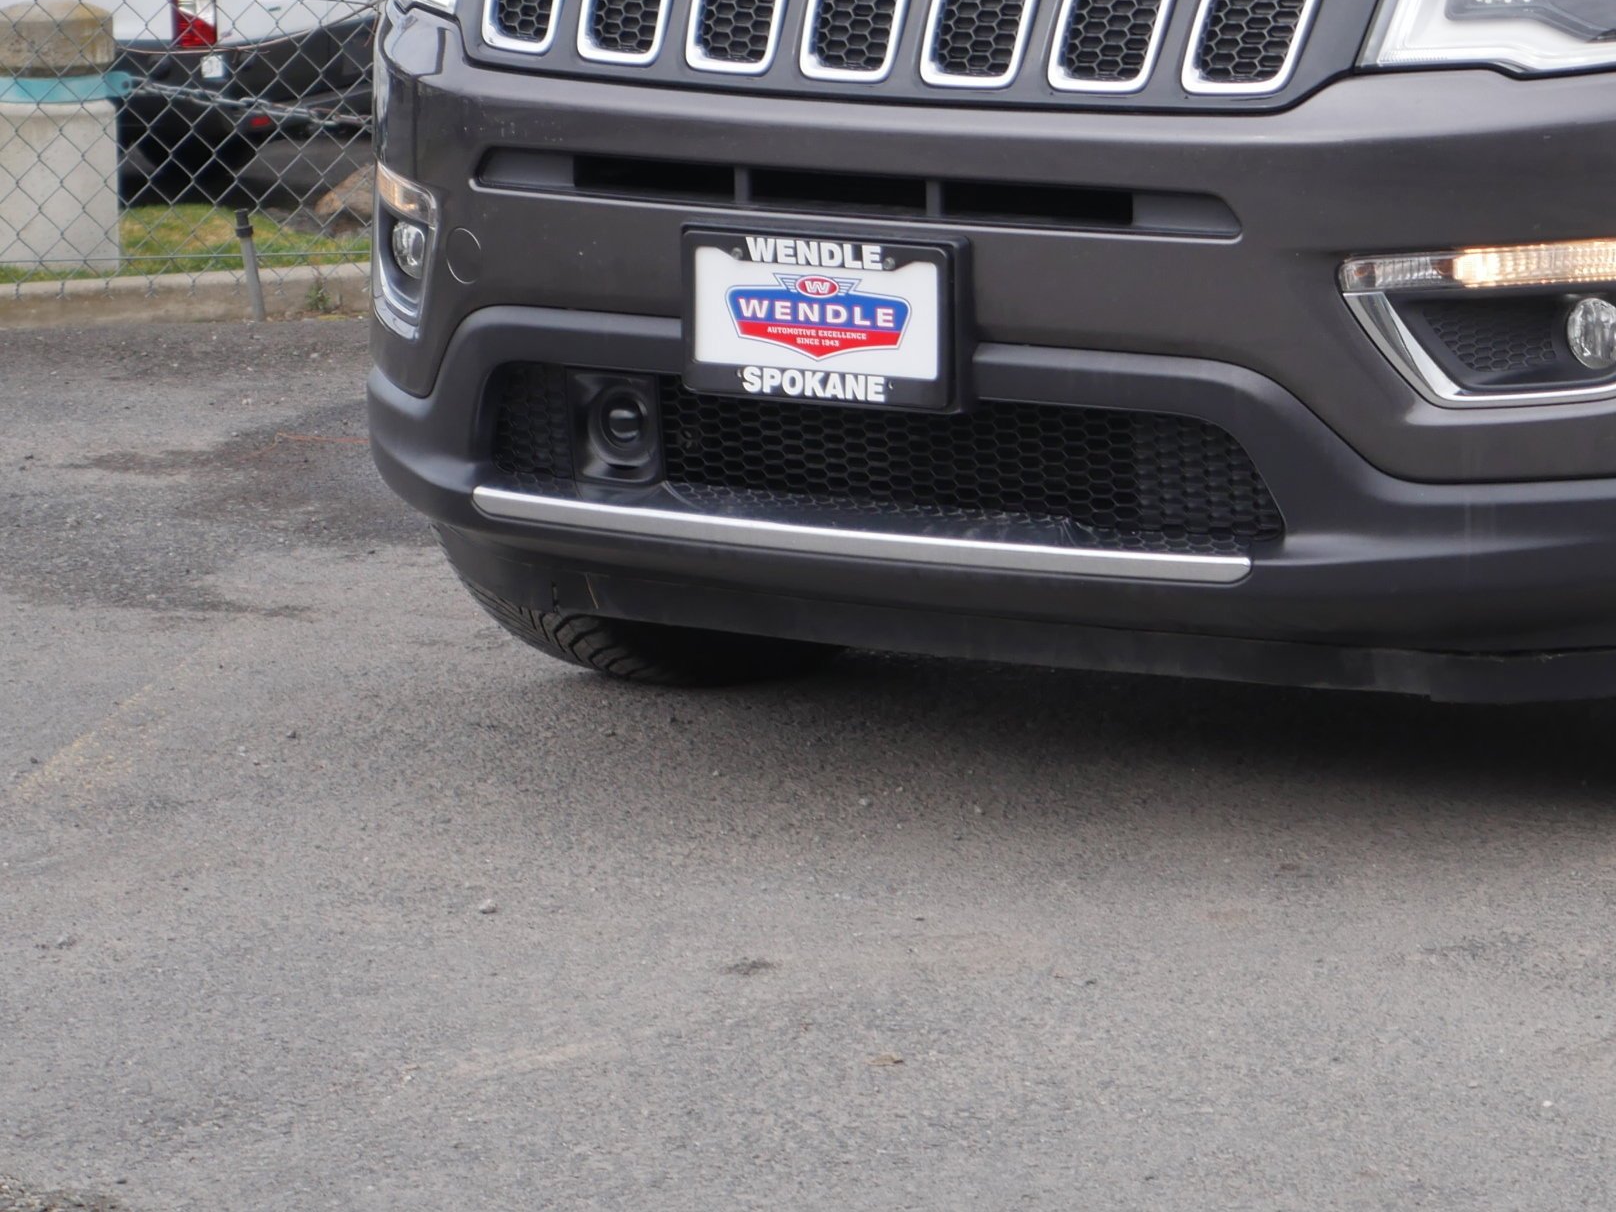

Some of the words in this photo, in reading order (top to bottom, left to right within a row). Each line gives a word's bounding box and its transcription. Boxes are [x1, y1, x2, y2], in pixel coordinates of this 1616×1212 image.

[745, 236, 883, 270] WENDLE
[738, 298, 895, 328] WENDLE
[767, 326, 816, 337] AUTOMOTIVE
[818, 329, 867, 340] EXCELLENCE
[796, 337, 820, 346] SINCE
[742, 366, 885, 402] SPOKANE
